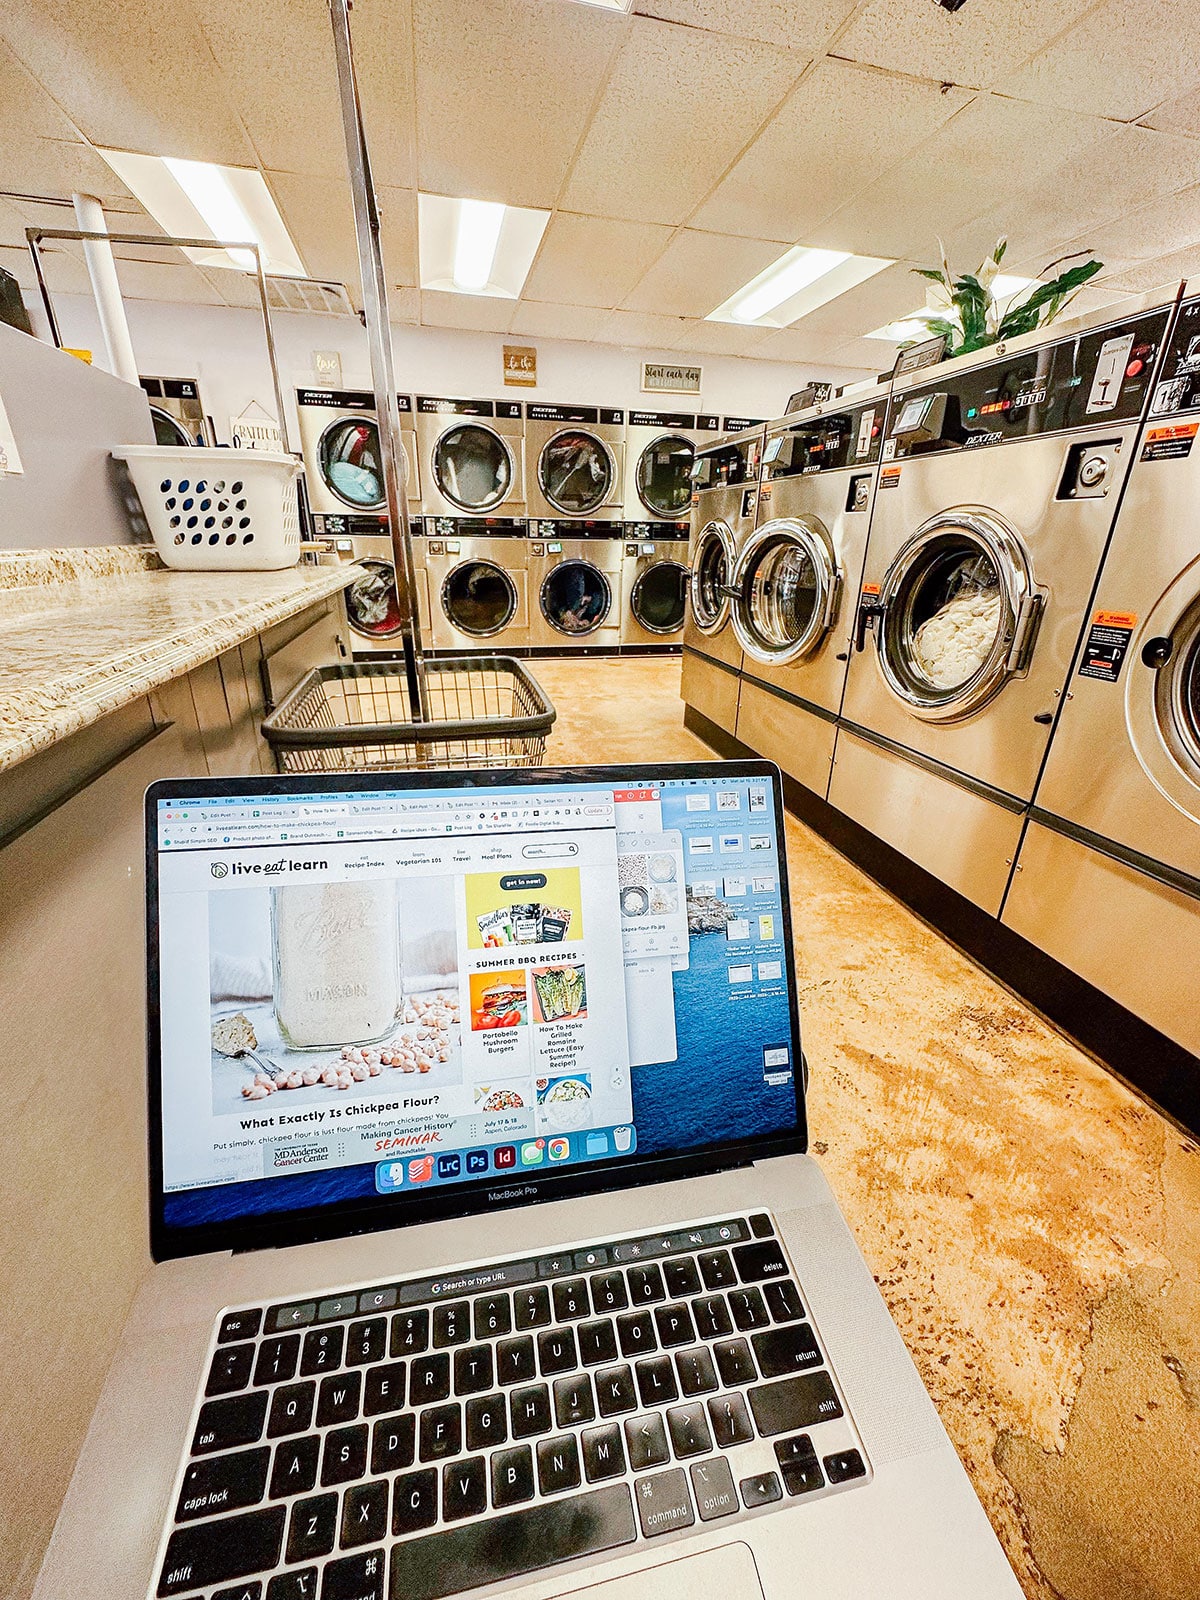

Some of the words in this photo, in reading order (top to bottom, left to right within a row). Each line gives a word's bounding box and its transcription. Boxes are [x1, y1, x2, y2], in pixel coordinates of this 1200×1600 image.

[317, 354, 337, 371] love
[645, 366, 664, 378] Start
[666, 370, 683, 379] each
[685, 370, 699, 382] day
[233, 424, 281, 441] GRATITUD
[965, 432, 1002, 445] DEXTER
[232, 863, 261, 875] live
[263, 859, 286, 875] eat
[289, 858, 328, 873] learn
[396, 858, 430, 866] Vegetarian
[506, 879, 517, 887] get
[478, 909, 509, 932] Smoothies
[476, 957, 515, 968] SUMMER
[518, 956, 536, 965] BBQ
[540, 952, 577, 962] RECIPES
[482, 1030, 519, 1039] Portobello
[539, 1025, 554, 1033] How
[483, 1038, 519, 1047] Mushroom
[547, 1038, 576, 1046] Romaine
[488, 1045, 515, 1055] Burgers
[540, 1046, 565, 1055] Lettuce
[566, 1044, 585, 1053] (Easy
[239, 1117, 275, 1130] What
[278, 1111, 326, 1125] Exactly
[329, 1107, 342, 1118] Is
[345, 1100, 399, 1117] Chickpea
[403, 1095, 440, 1109] Flour?
[485, 1120, 496, 1128] July
[485, 1127, 503, 1135] Aspen,
[504, 1124, 527, 1132] Colorado
[213, 1142, 228, 1151] Put
[258, 1133, 293, 1145] chickpea
[294, 1130, 312, 1141] flour
[321, 1126, 335, 1137] just
[336, 1124, 354, 1134] flour
[355, 1121, 377, 1130] made
[378, 1119, 396, 1127] from
[436, 1112, 449, 1120] You
[361, 1132, 392, 1142] Making
[394, 1126, 421, 1137] Cancer
[374, 1131, 443, 1151] SEMINAR
[274, 1150, 290, 1160] MD
[290, 1145, 328, 1158] Anderson
[499, 1153, 511, 1164] Id
[273, 1156, 302, 1167] Cancer
[302, 1153, 328, 1164] Center
[440, 1160, 459, 1173] LrC
[470, 1156, 485, 1168] Ps
[488, 1188, 523, 1201] MacBook
[525, 1186, 538, 1195] Pro
[763, 1261, 783, 1273] delete
[442, 1279, 467, 1292] Search
[467, 1278, 475, 1286] or
[476, 1275, 491, 1287] type
[492, 1271, 506, 1282] URL
[644, 1284, 652, 1296] 0
[606, 1292, 614, 1303] 9
[568, 1300, 576, 1311] 8
[530, 1308, 536, 1320] 7
[226, 1320, 241, 1331] esc
[489, 1317, 497, 1328] 6
[671, 1318, 679, 1331] P
[448, 1325, 455, 1336] 5
[632, 1326, 641, 1339] O
[405, 1334, 413, 1345] 4
[595, 1335, 600, 1348] I
[362, 1342, 370, 1354] 3
[553, 1343, 562, 1356] U
[317, 1351, 325, 1364] 2
[512, 1352, 520, 1366] Y
[795, 1349, 817, 1362] return
[273, 1360, 279, 1372] 1
[469, 1362, 478, 1375] T
[425, 1371, 434, 1385] R
[653, 1373, 661, 1387] L
[381, 1381, 389, 1395] E
[611, 1383, 621, 1397] K
[333, 1390, 346, 1405] W
[571, 1393, 578, 1406] J
[287, 1400, 297, 1417] Q
[526, 1403, 536, 1417] H
[818, 1398, 837, 1413] shift
[482, 1413, 491, 1428] G
[199, 1431, 214, 1445] tab
[436, 1424, 444, 1439] F
[388, 1435, 399, 1450] D
[340, 1446, 350, 1462] S
[598, 1445, 609, 1460] M
[289, 1457, 300, 1475] A
[554, 1455, 563, 1471] N
[508, 1468, 516, 1484] B
[460, 1478, 469, 1495] V
[184, 1494, 207, 1511] caps
[208, 1489, 229, 1504] lock
[410, 1492, 420, 1508] C
[704, 1493, 730, 1510] option
[359, 1503, 370, 1523] X
[647, 1504, 688, 1525] command
[307, 1517, 317, 1536] Z
[167, 1566, 192, 1585] shift
